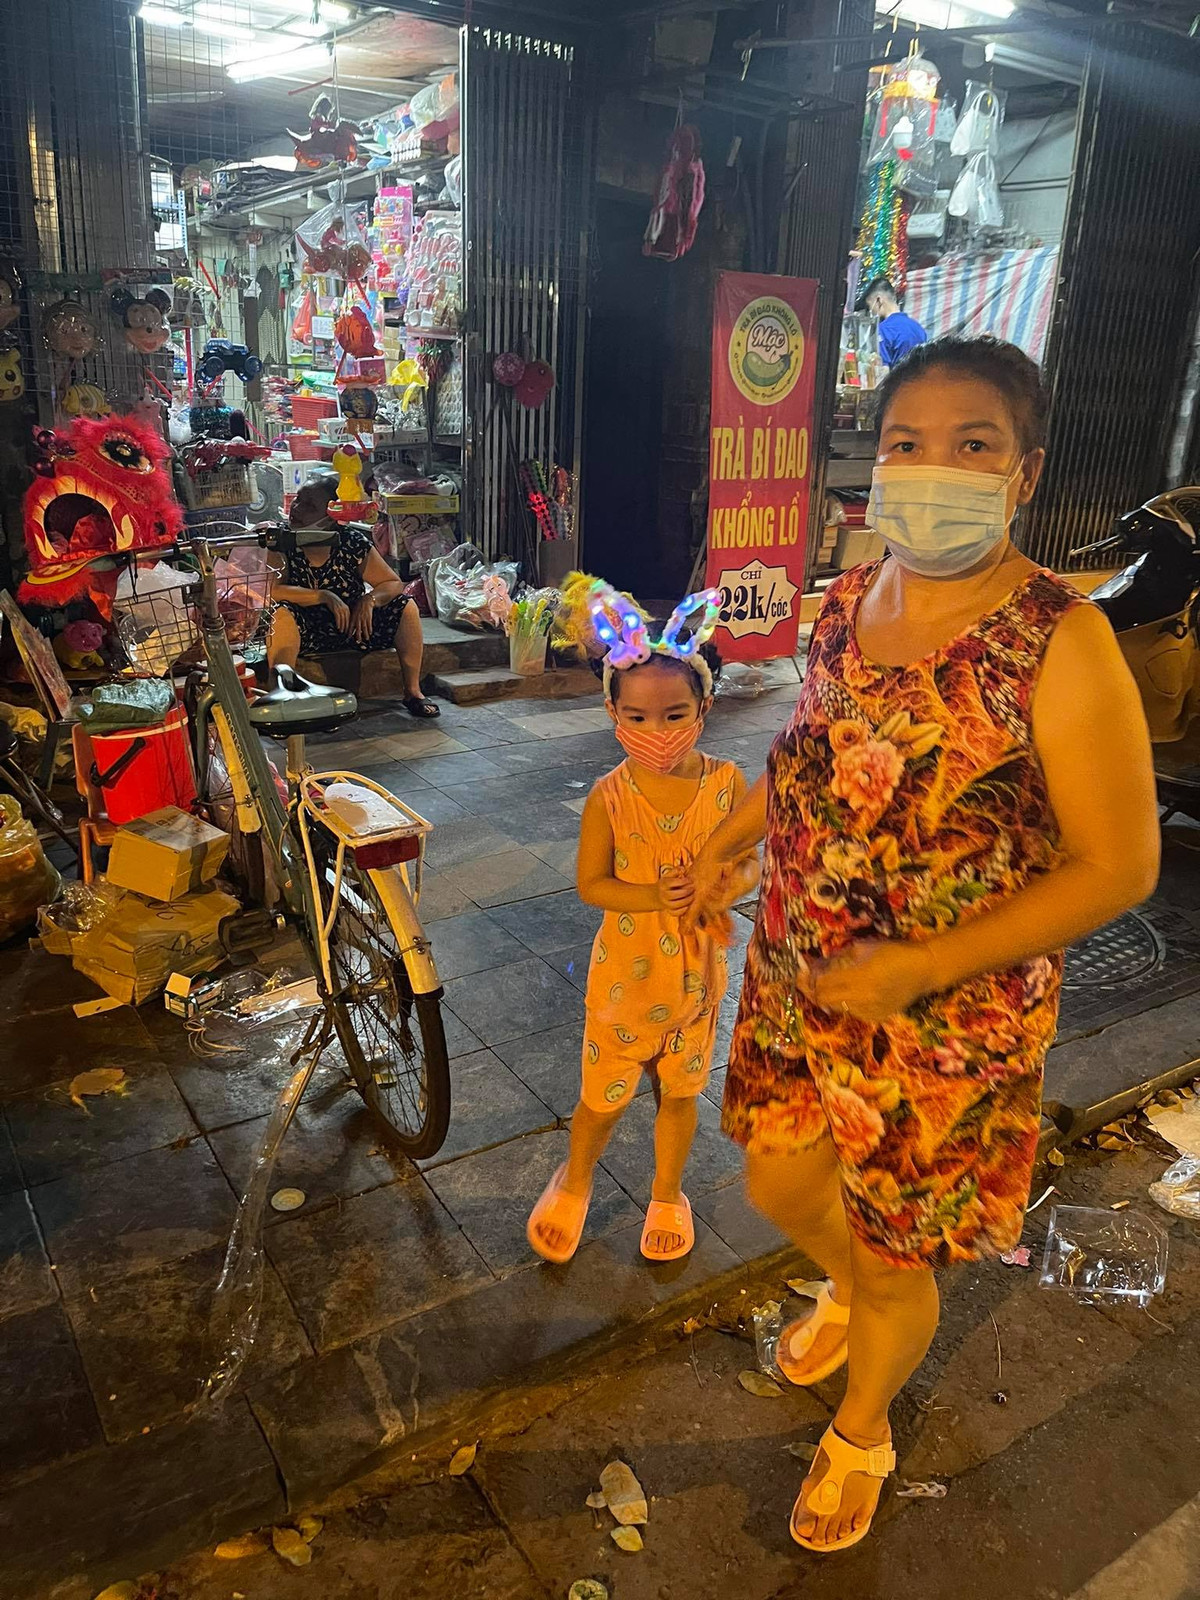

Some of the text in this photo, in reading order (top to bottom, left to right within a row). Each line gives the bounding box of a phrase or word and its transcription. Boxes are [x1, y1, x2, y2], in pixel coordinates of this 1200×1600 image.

[752, 324, 785, 352] Mộc
[712, 415, 808, 480] TRÀ BÍ ĐAO
[711, 490, 800, 549] KHỔNG LỒ
